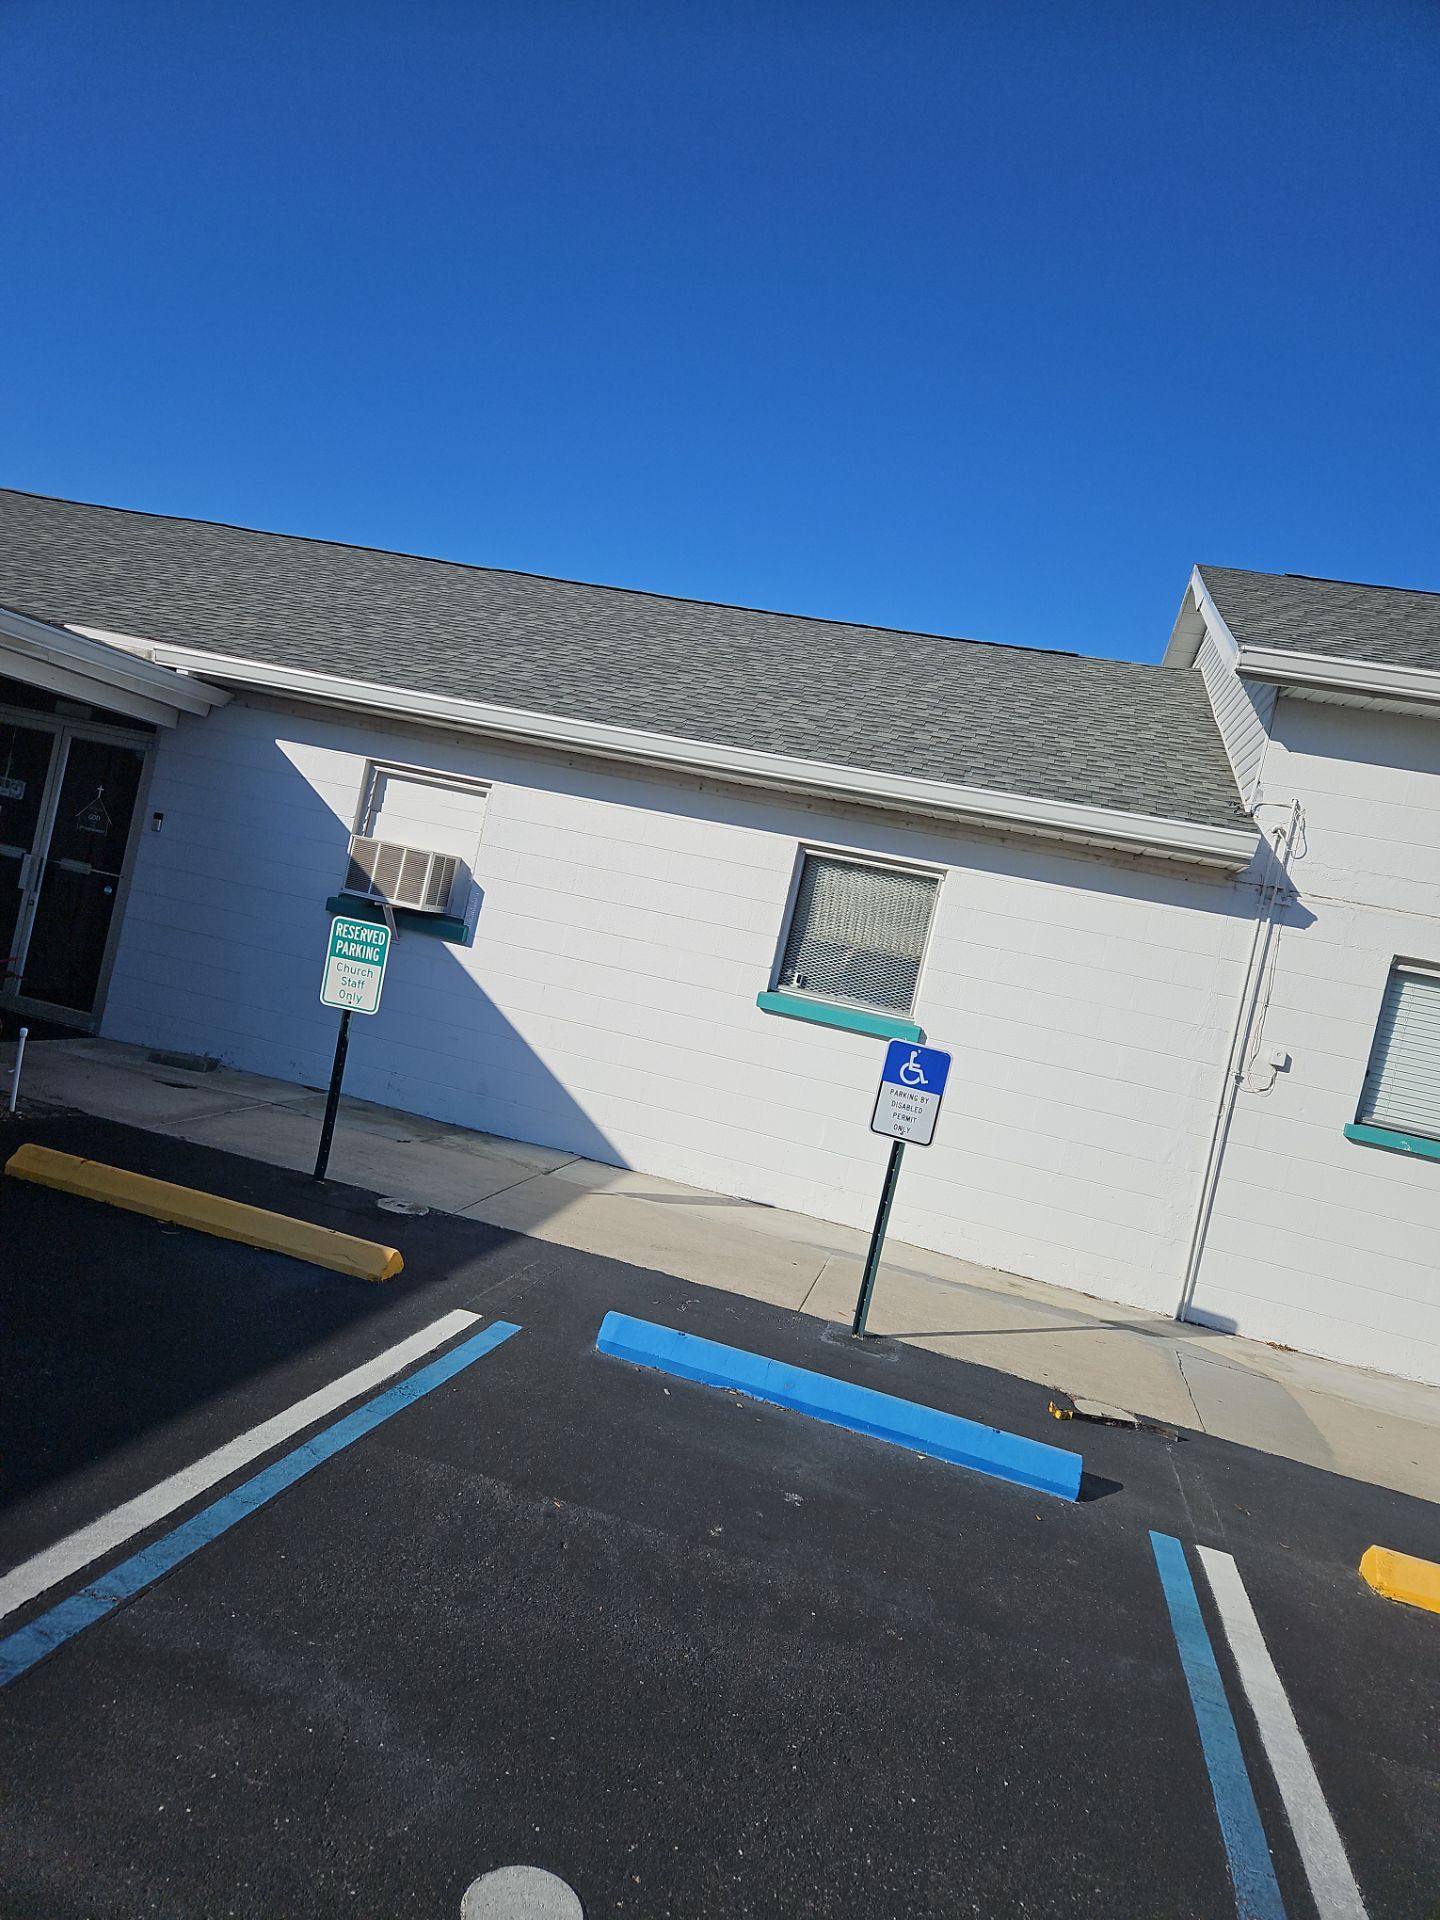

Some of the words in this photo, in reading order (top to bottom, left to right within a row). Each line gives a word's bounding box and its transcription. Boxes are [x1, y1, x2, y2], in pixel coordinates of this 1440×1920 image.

[335, 922, 386, 946] RESERVED
[335, 939, 380, 962] PARKING
[336, 962, 374, 978] Church
[341, 976, 365, 990] Staff
[338, 989, 363, 1004] Only
[889, 1088, 918, 1102] PARKING
[919, 1096, 930, 1104] BY
[890, 1100, 923, 1114] DISABLED
[892, 1111, 918, 1123] PERMIT
[893, 1123, 911, 1134] ONLY
